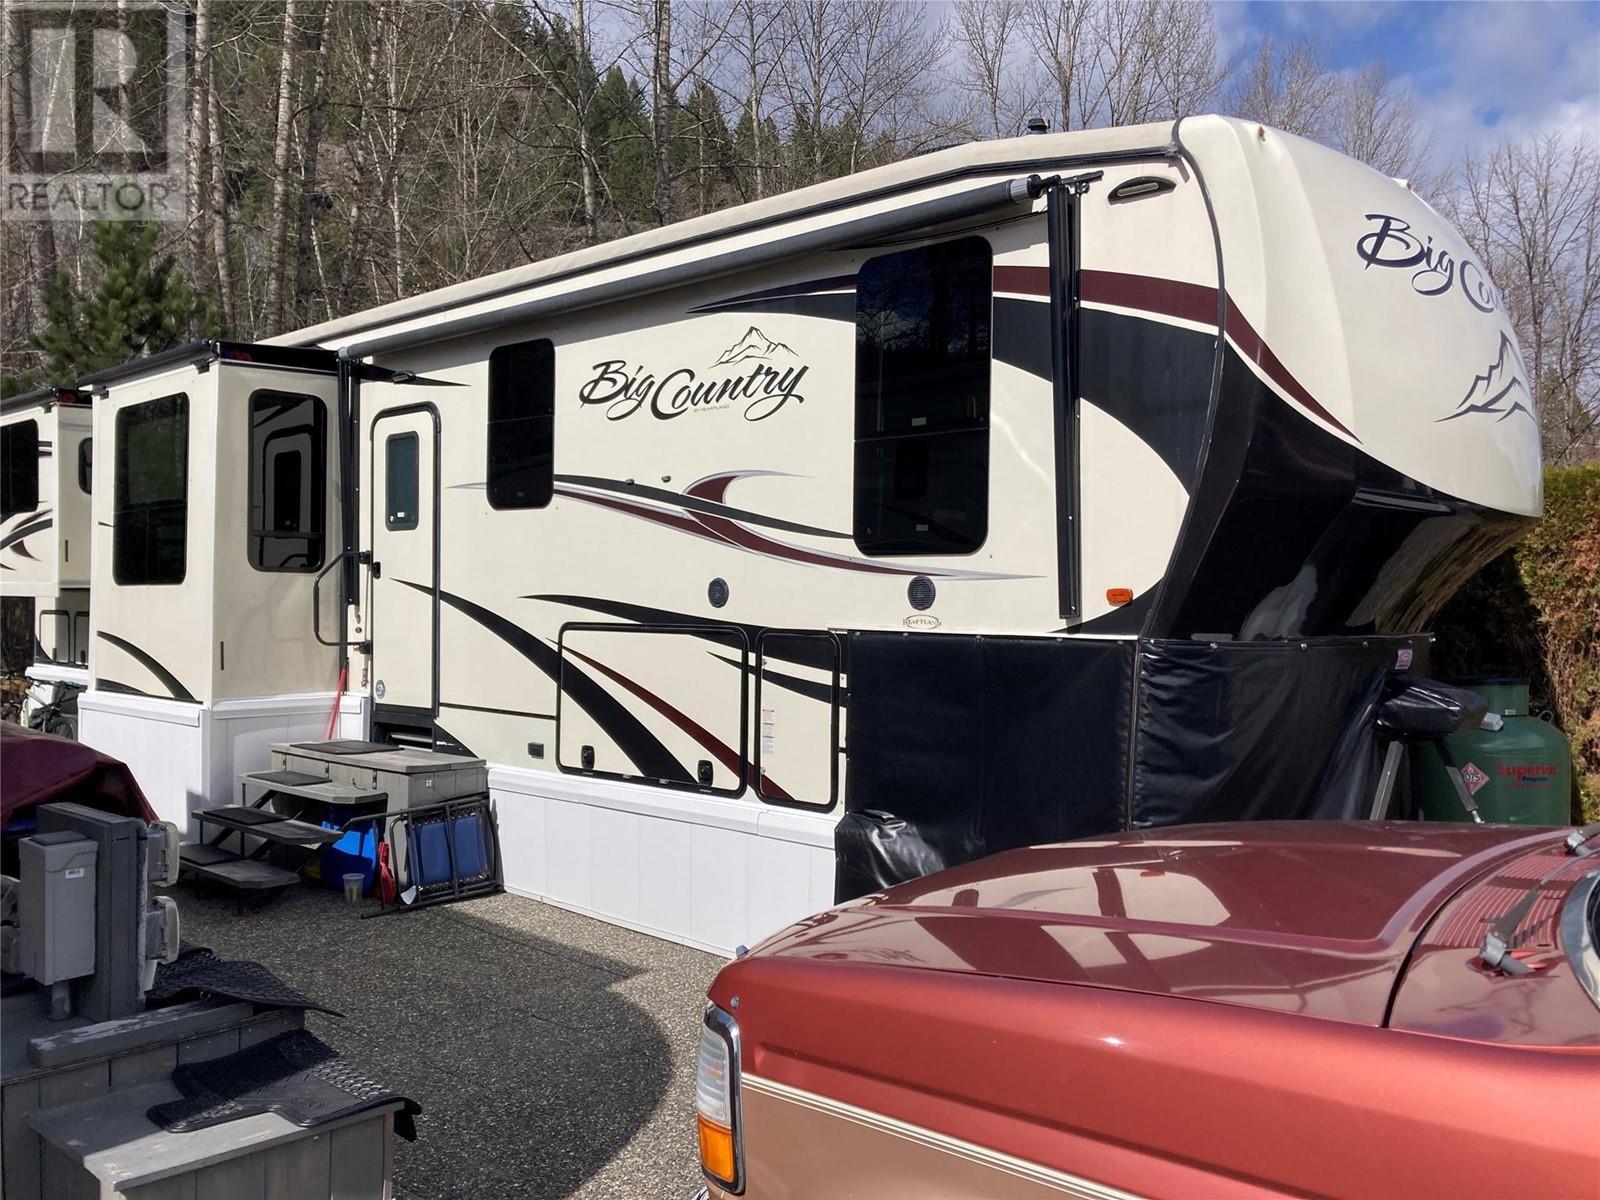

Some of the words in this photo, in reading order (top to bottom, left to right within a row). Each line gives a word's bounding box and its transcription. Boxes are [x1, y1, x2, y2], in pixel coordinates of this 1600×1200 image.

[1356, 213, 1455, 296] Big
[579, 359, 656, 421] Big
[650, 364, 810, 422] Country
